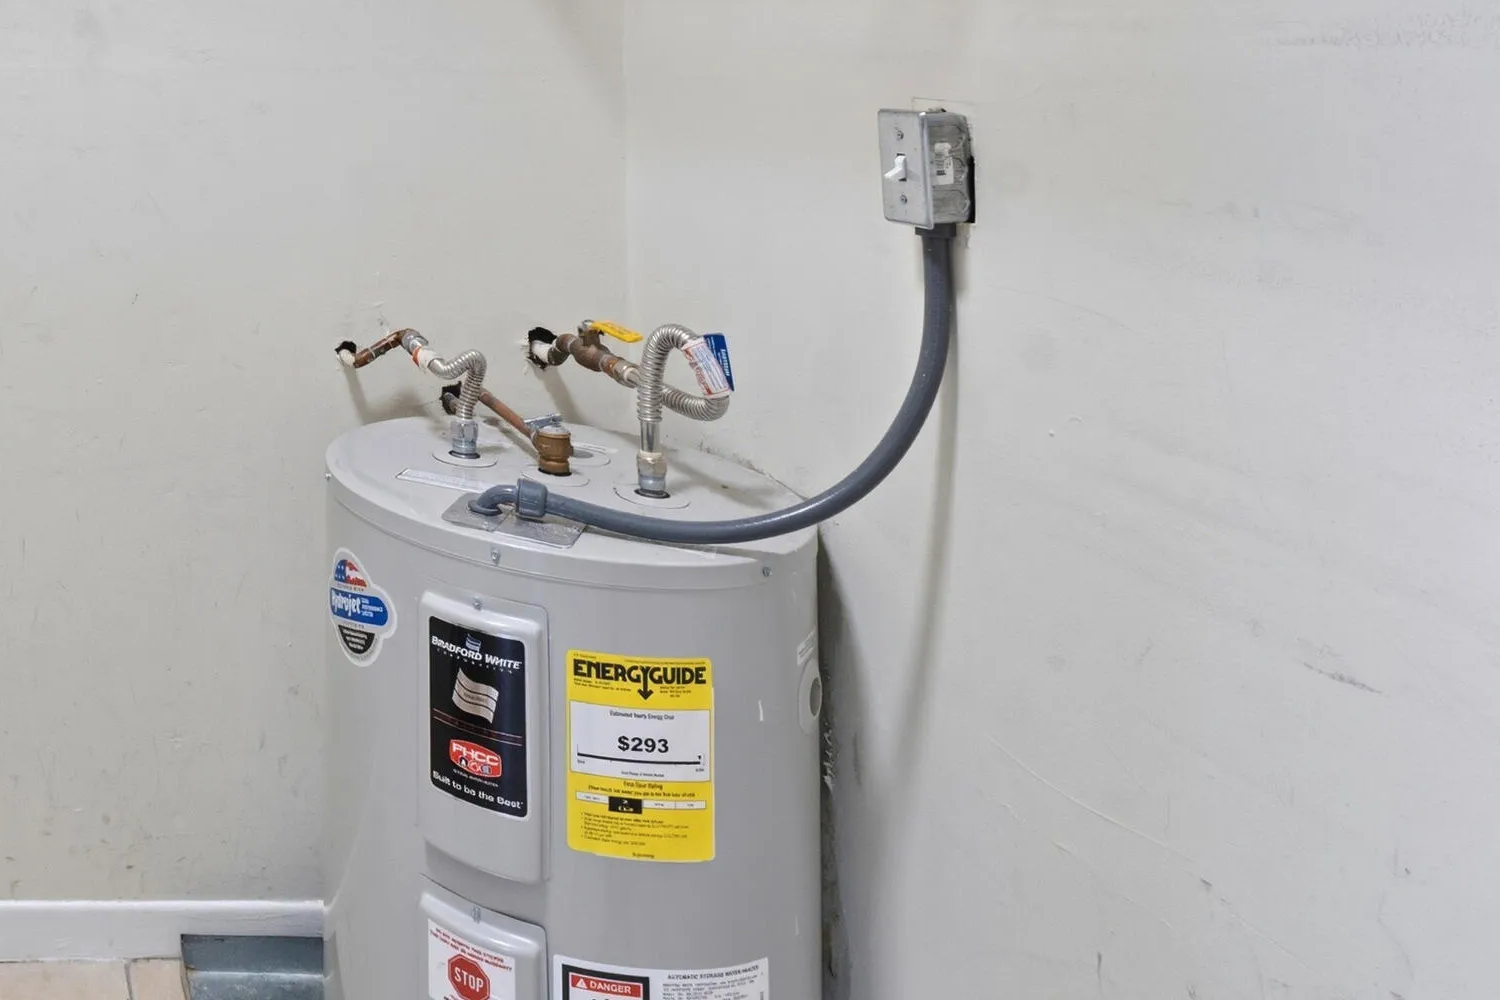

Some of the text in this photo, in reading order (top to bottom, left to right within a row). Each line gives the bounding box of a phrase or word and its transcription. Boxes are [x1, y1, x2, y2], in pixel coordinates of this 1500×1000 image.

[431, 635, 482, 661] BRADFORD
[484, 653, 520, 670] WHITE
[452, 742, 499, 766] PHCC
[617, 735, 669, 754] $293
[452, 781, 462, 790] to
[463, 785, 476, 796] be
[478, 791, 495, 802] the
[454, 966, 484, 993] STOP
[589, 980, 632, 994] DANGER
